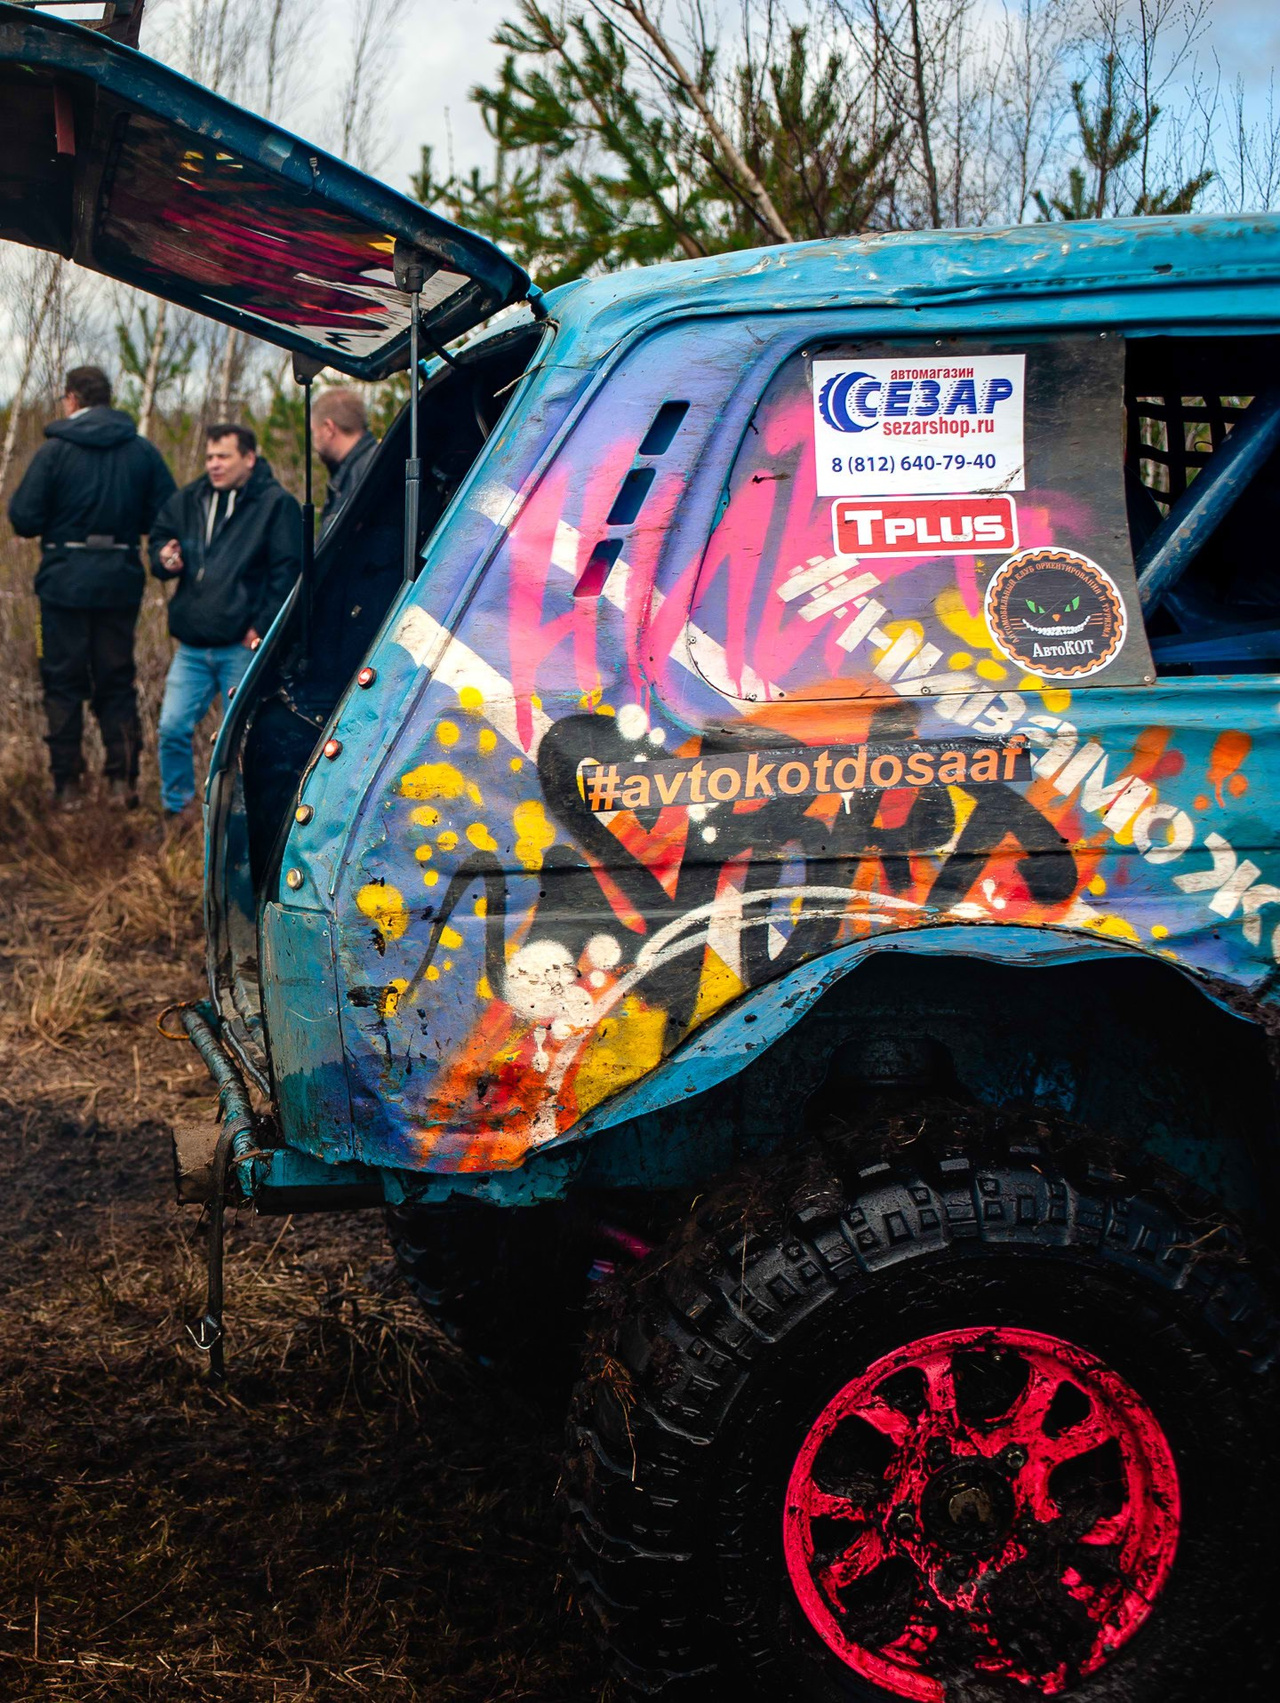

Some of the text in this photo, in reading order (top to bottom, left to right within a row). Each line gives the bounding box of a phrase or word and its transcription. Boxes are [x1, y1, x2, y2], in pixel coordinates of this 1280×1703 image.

[890, 367, 974, 380] автомагазин
[849, 378, 1013, 418] СЕЗАР
[882, 417, 995, 437] sezarshop.ru
[831, 453, 997, 473] 8 (812) 640-79-40
[844, 509, 1006, 546] TPLUS
[1015, 565, 1035, 580] КЛУБ
[586, 733, 1029, 811] #avtokotdosaaf
